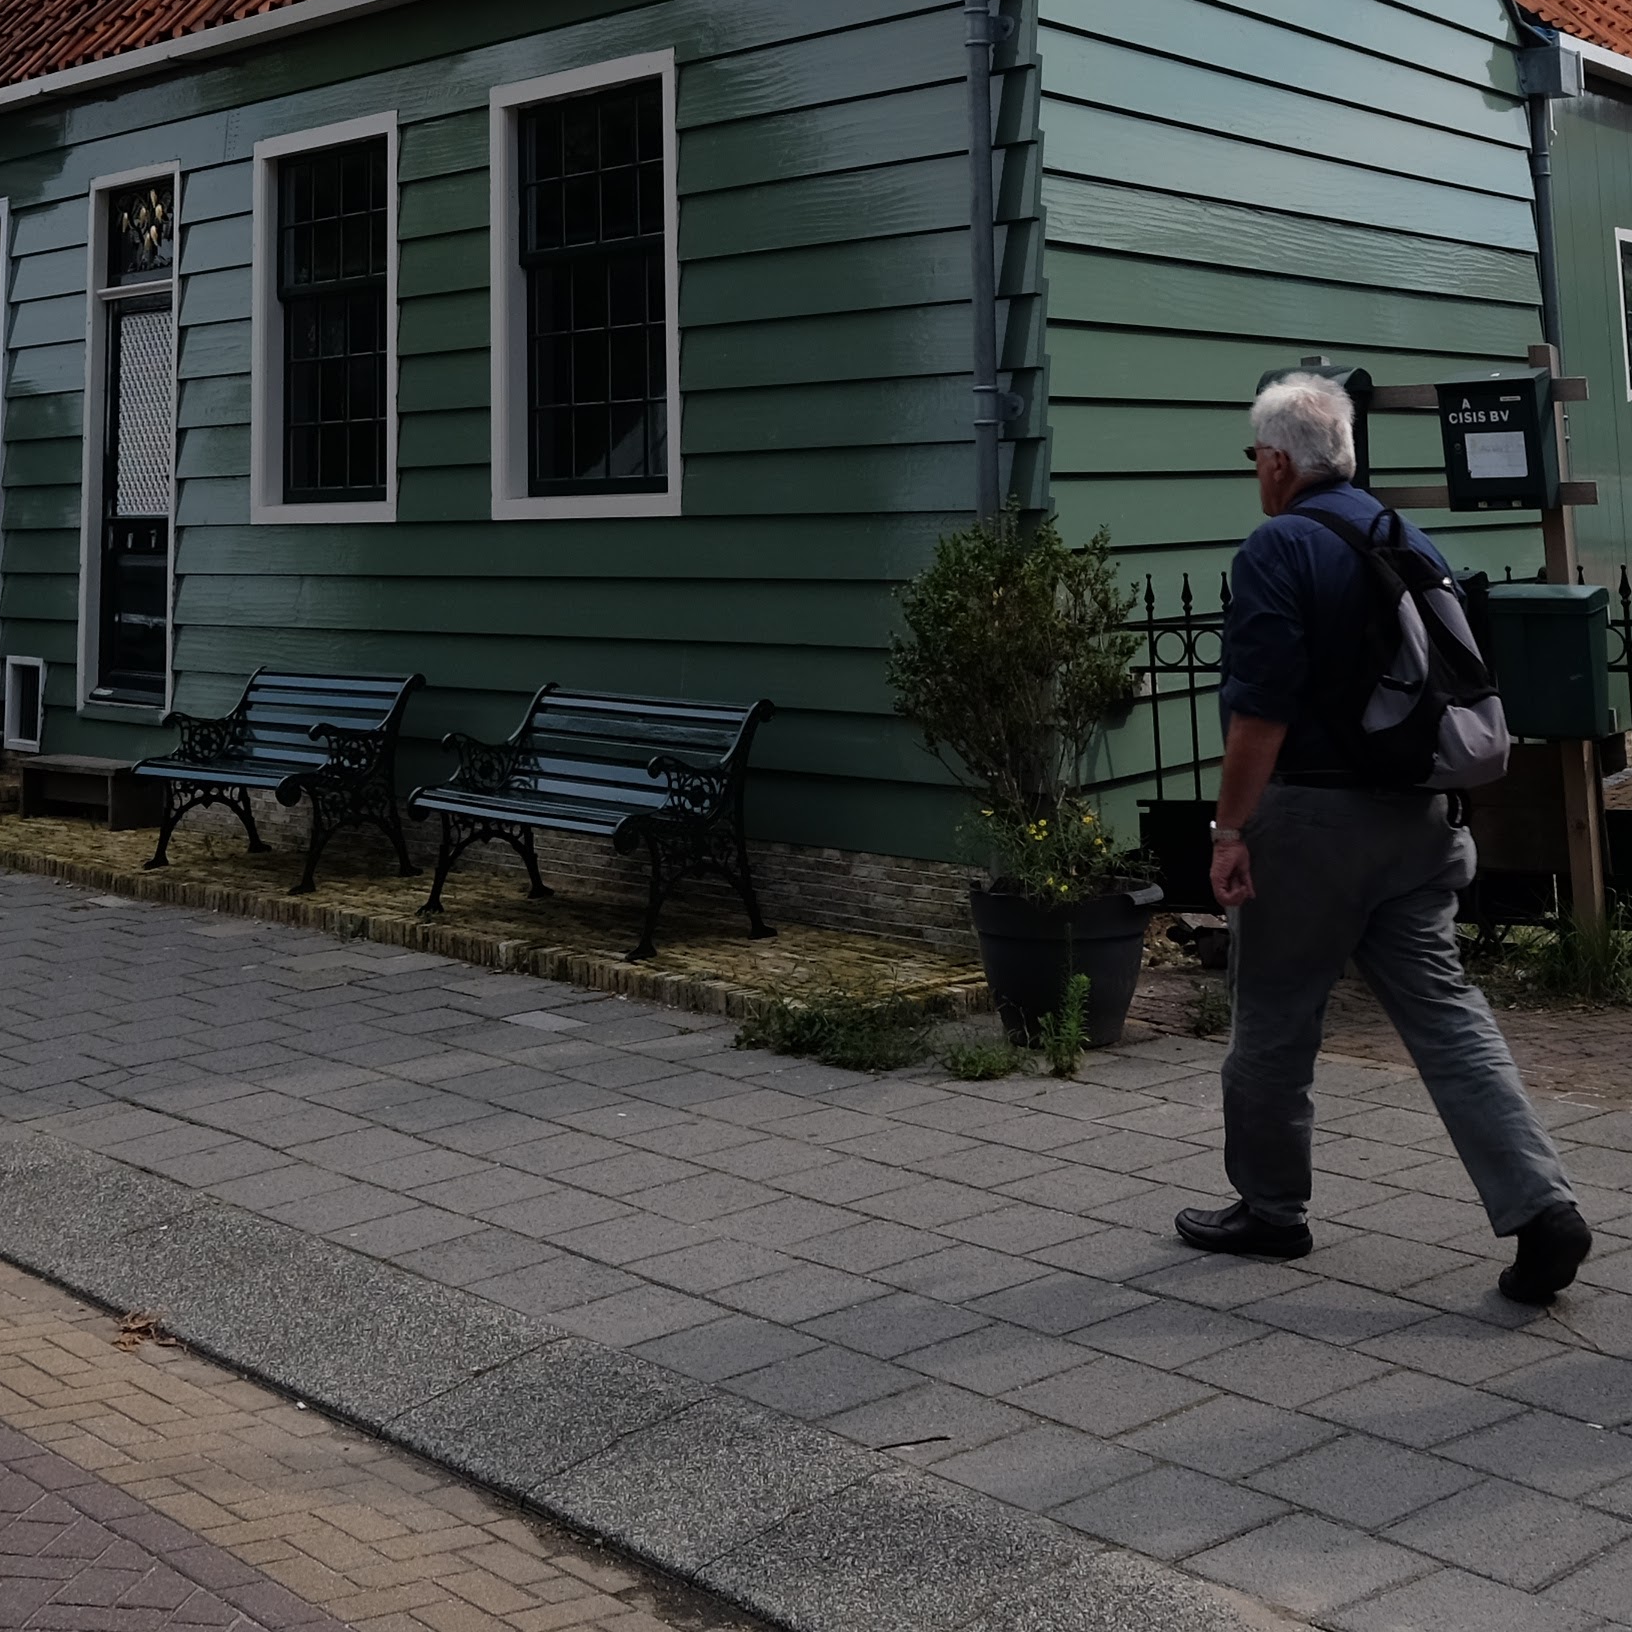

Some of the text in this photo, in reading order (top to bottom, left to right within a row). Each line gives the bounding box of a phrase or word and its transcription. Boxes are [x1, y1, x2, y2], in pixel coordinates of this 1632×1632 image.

[1462, 398, 1471, 409] A
[1448, 409, 1510, 424] CISIS BV
